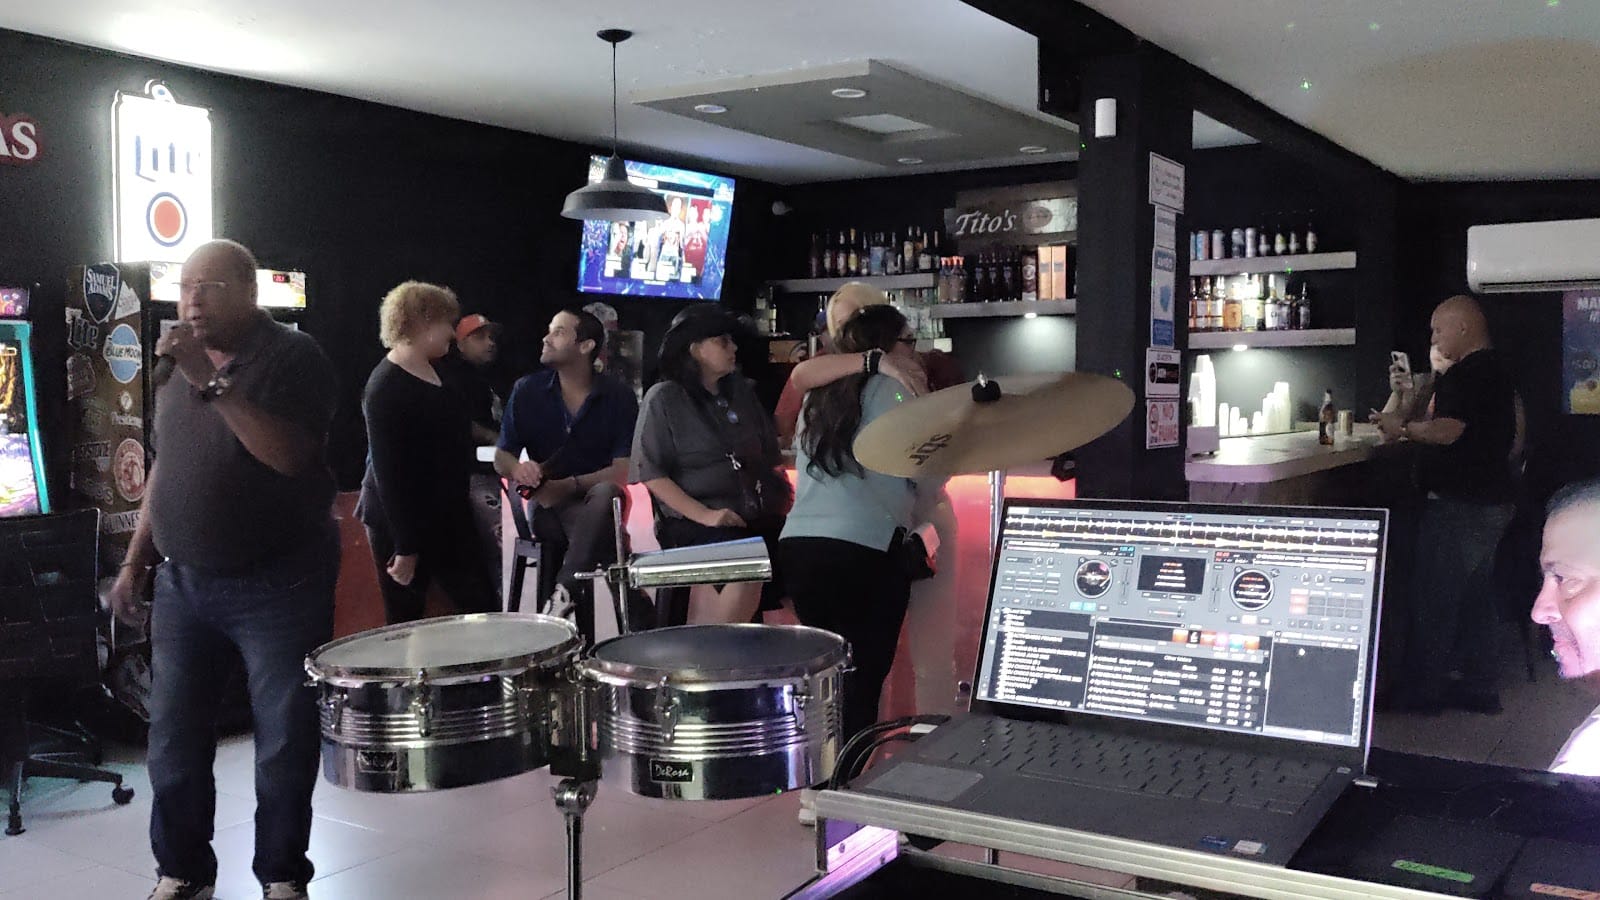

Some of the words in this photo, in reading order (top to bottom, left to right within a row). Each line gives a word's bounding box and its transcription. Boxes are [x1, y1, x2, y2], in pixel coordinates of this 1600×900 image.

[956, 209, 1017, 235] Tito's
[106, 346, 122, 358] BLUE
[124, 346, 142, 360] MOON
